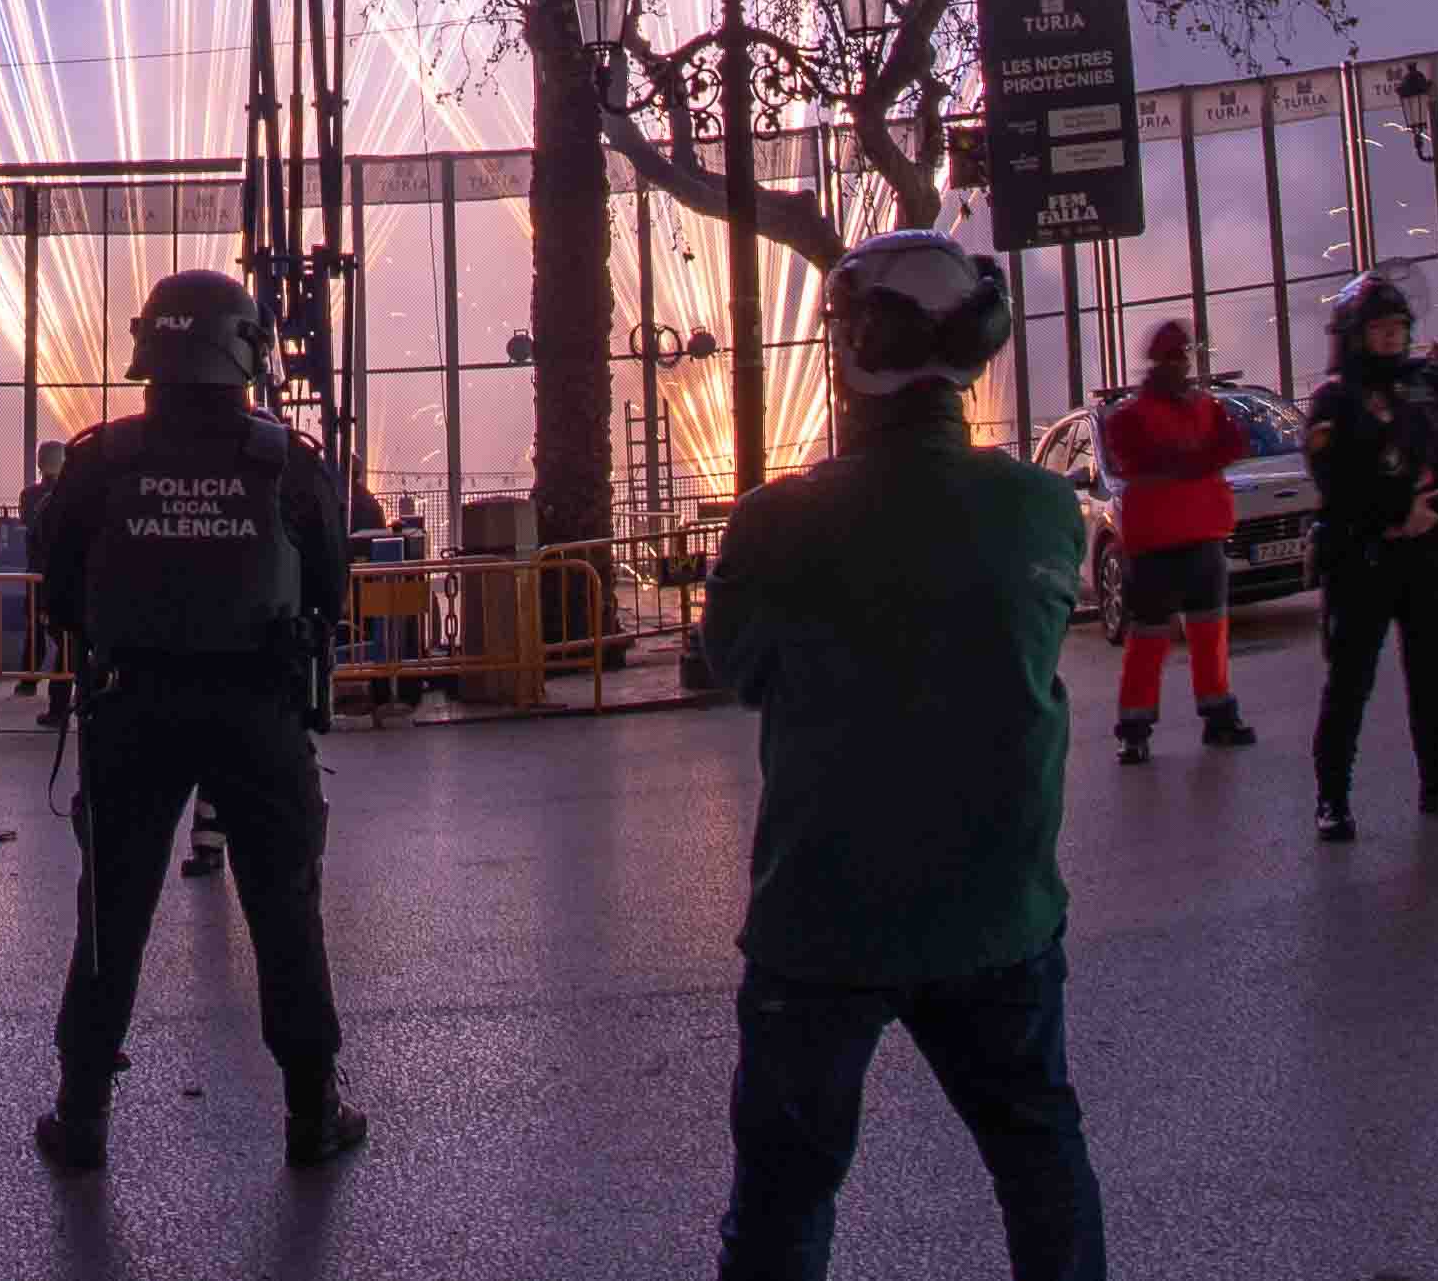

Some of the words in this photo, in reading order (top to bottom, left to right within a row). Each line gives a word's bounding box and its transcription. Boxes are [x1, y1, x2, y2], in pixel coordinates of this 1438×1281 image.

[1023, 12, 1086, 32] TURIA
[1002, 58, 1033, 75] LES
[1035, 49, 1114, 73] NOSTRES
[1282, 94, 1328, 109] TURIA
[1205, 105, 1251, 120] TURIA
[1047, 191, 1088, 209] FEM
[1036, 205, 1099, 226] FALLA
[155, 315, 194, 330] PLV
[162, 501, 223, 515] LOCAL
